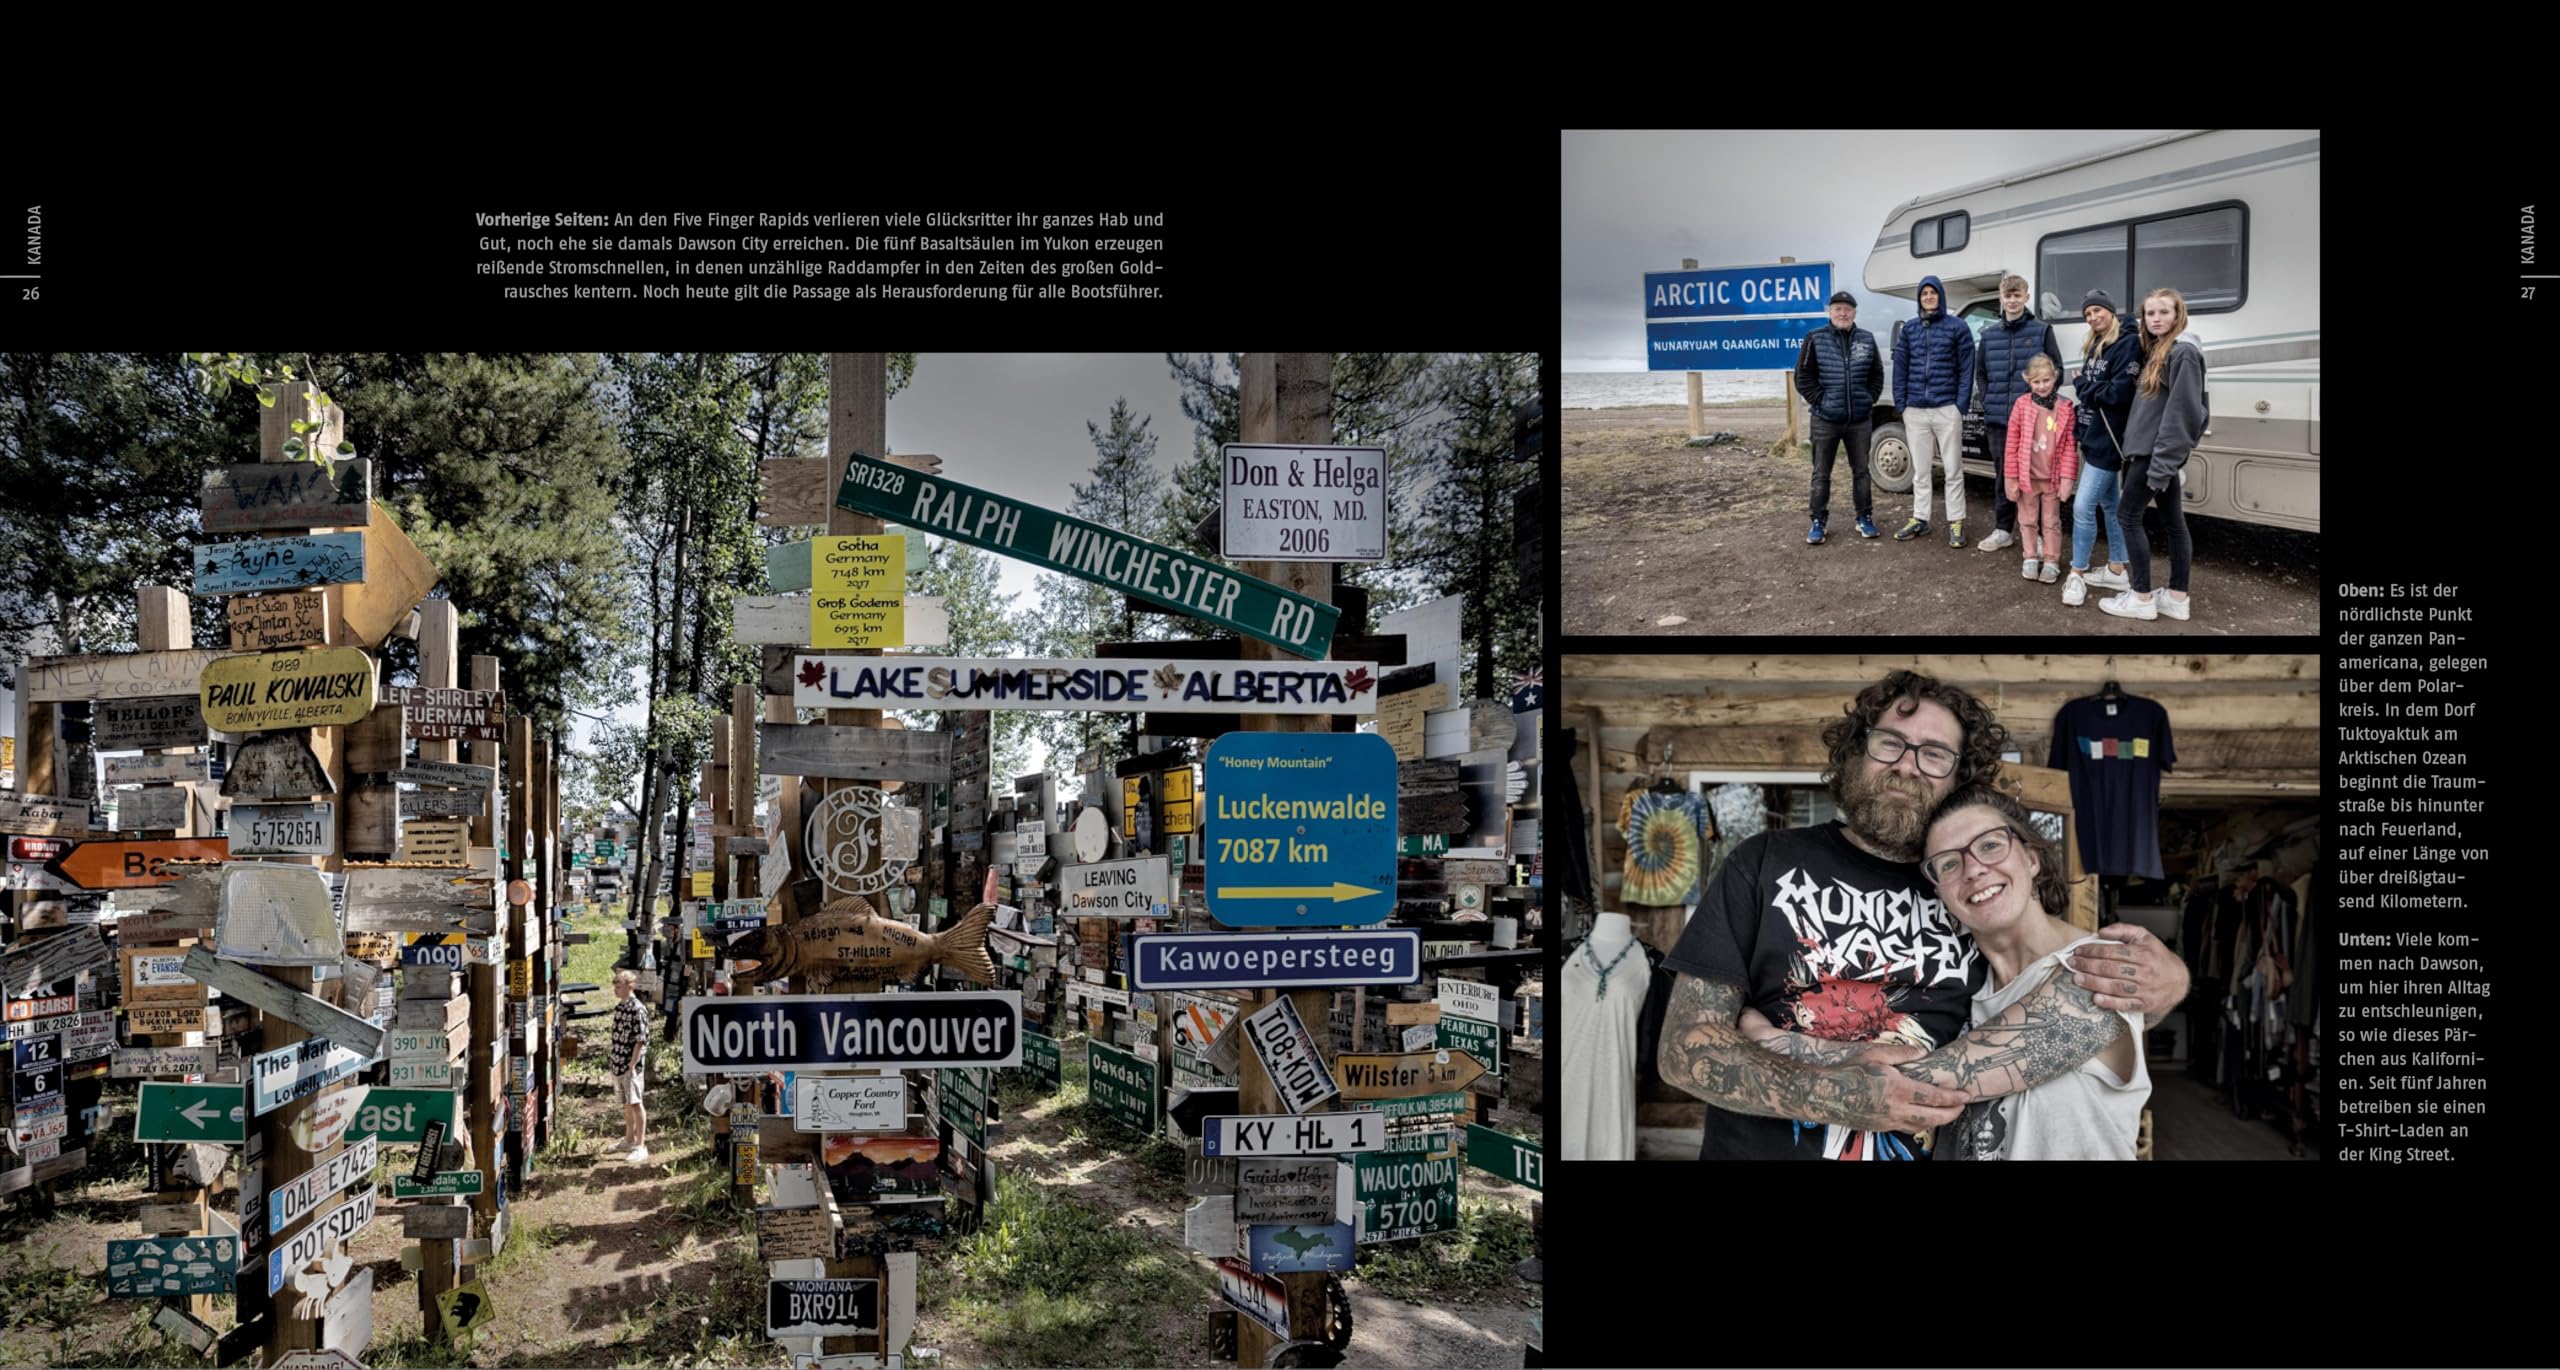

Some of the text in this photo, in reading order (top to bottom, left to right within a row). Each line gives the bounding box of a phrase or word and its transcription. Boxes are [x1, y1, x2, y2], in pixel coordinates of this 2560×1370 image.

[1654, 276, 1820, 306] ARCTIC OCEAN
[1654, 338, 1780, 351] NUNARYUAM QAANGANI
[1231, 456, 1380, 495] Don & Helga
[1242, 498, 1367, 523] EASTON, MD.
[837, 540, 879, 552] Gotha
[1280, 528, 1330, 553] 2006
[231, 549, 296, 576] Payne
[306, 552, 331, 574] July
[825, 553, 890, 565] Germany
[846, 461, 1316, 645] SR1328 RALPH WINCHESTER RD
[326, 552, 351, 575] 2017
[831, 565, 885, 578] 7148 km
[234, 597, 319, 616] Jim Susan Potts
[817, 597, 900, 610] Groß Godems
[251, 611, 311, 631] Clinton SC
[829, 610, 887, 622] Germany
[258, 629, 324, 648] August 2015
[834, 623, 882, 634] 6915 km
[36, 661, 110, 689] NEW
[271, 658, 300, 672] 1989
[115, 679, 192, 696] COOGAN
[208, 671, 366, 709] PAUL KOWALSKI
[829, 665, 1347, 704] LAKE SUMMERSIDE ALBERTA
[422, 726, 466, 738] CLIFF
[19, 807, 64, 820] Kabat
[1218, 793, 1386, 820] Luckenwalde
[1217, 837, 1328, 863] 7087 km
[1084, 868, 1136, 887] LEAVING
[1073, 891, 1153, 911] Dawson City
[882, 926, 917, 946] Michel
[1159, 944, 1395, 976] Kawoepersteeg
[1441, 944, 1464, 958] OHIO
[1798, 926, 1979, 986] WASTE
[11, 997, 73, 1018] GO BEARS!
[1452, 999, 1479, 1011] OHIO
[8, 1025, 24, 1038] HH
[34, 1022, 49, 1034] UK
[53, 1015, 80, 1030] 2826
[698, 1009, 1008, 1059] North Vancouver
[1441, 1019, 1489, 1038] PEARLAND
[28, 1042, 49, 1062] 12
[394, 1036, 417, 1050] 390
[1450, 1035, 1480, 1051] TEXAS
[173, 1064, 194, 1073] 2017
[257, 1055, 290, 1078] The
[393, 1065, 449, 1080] 931 KLR
[1176, 1053, 1197, 1072] TOWN
[34, 1074, 46, 1092] 6
[1344, 1062, 1457, 1087] Wilster 5 km
[274, 1066, 340, 1105] Lowell, MA
[828, 1088, 900, 1101] Copper Country
[853, 1100, 875, 1110] Ford
[1093, 1079, 1147, 1115] CITY LIMIT
[1429, 1098, 1451, 1111] 3854
[1236, 1121, 1274, 1152] KY
[1296, 1119, 1333, 1150] HL
[1351, 1118, 1367, 1148] 1
[285, 1177, 318, 1219] OAL
[328, 1161, 338, 1192] E
[342, 1145, 368, 1183] 742
[463, 1174, 479, 1184] CO
[1243, 1168, 1287, 1185] Guido
[1361, 1160, 1454, 1192] WAUCONDA
[1380, 1199, 1437, 1229] 5700
[795, 1281, 853, 1292] MONTANA
[789, 1294, 859, 1321] BXR914
